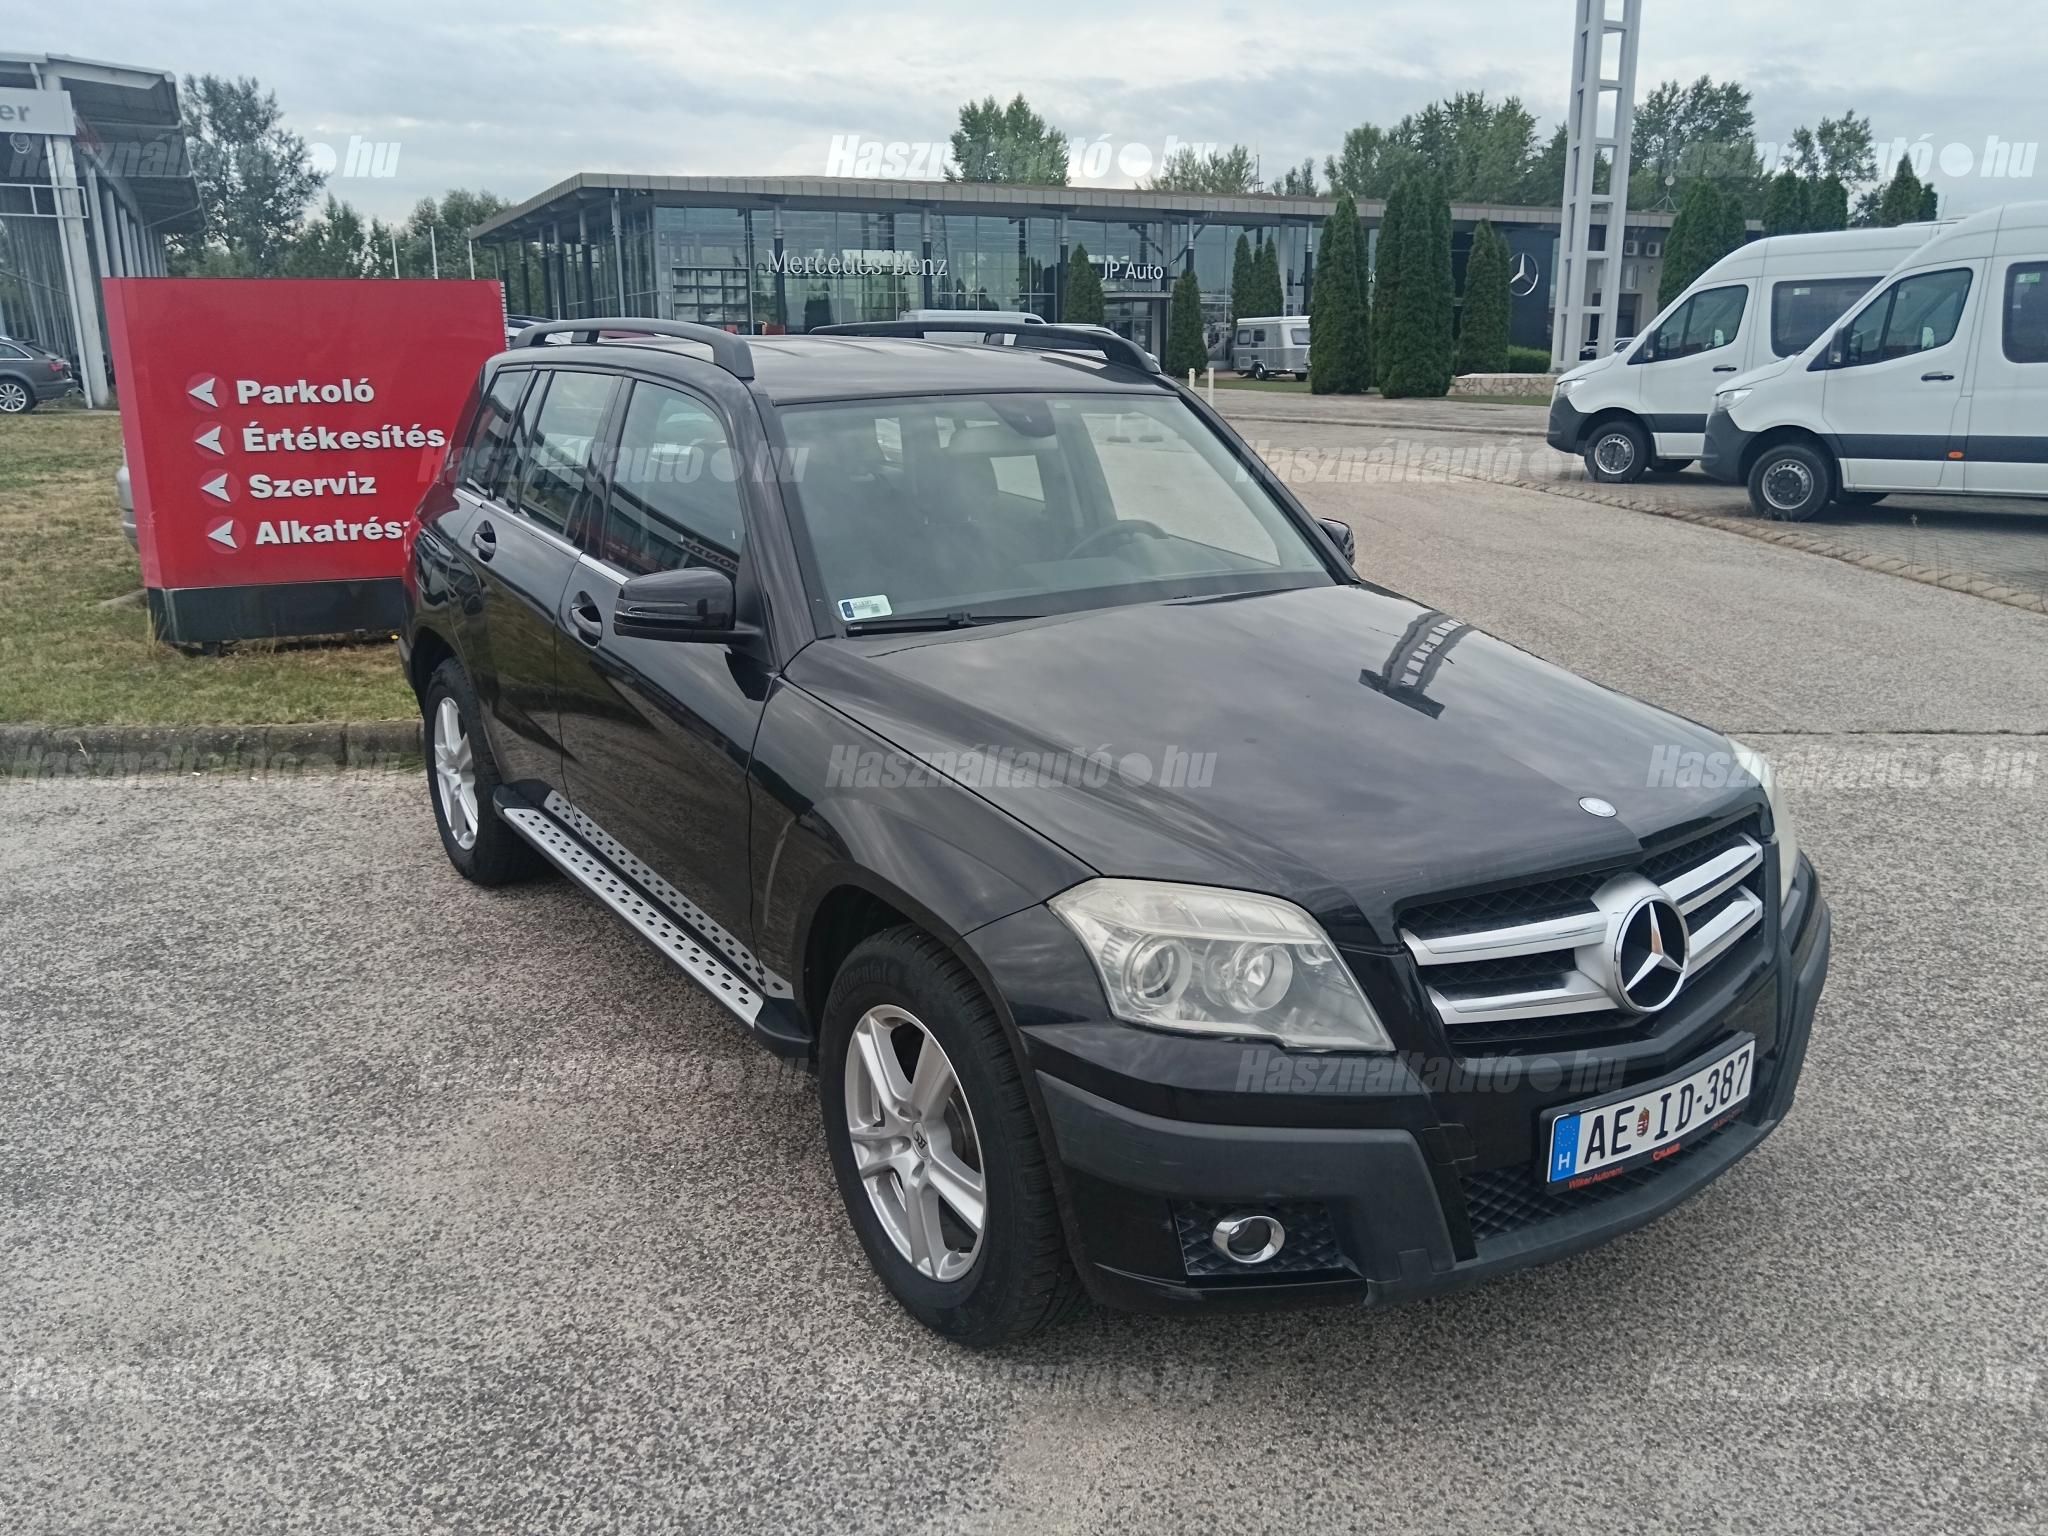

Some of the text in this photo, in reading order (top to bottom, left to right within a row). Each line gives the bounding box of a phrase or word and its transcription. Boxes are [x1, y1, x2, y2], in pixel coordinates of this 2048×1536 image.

[1102, 260, 1164, 280] JP Auto
[236, 378, 375, 404] Parkoló
[243, 421, 446, 452] Értékesítés
[249, 471, 377, 498] Szerviz
[1584, 1049, 1750, 1165] AE ID-387
[1558, 1152, 1571, 1170] H
